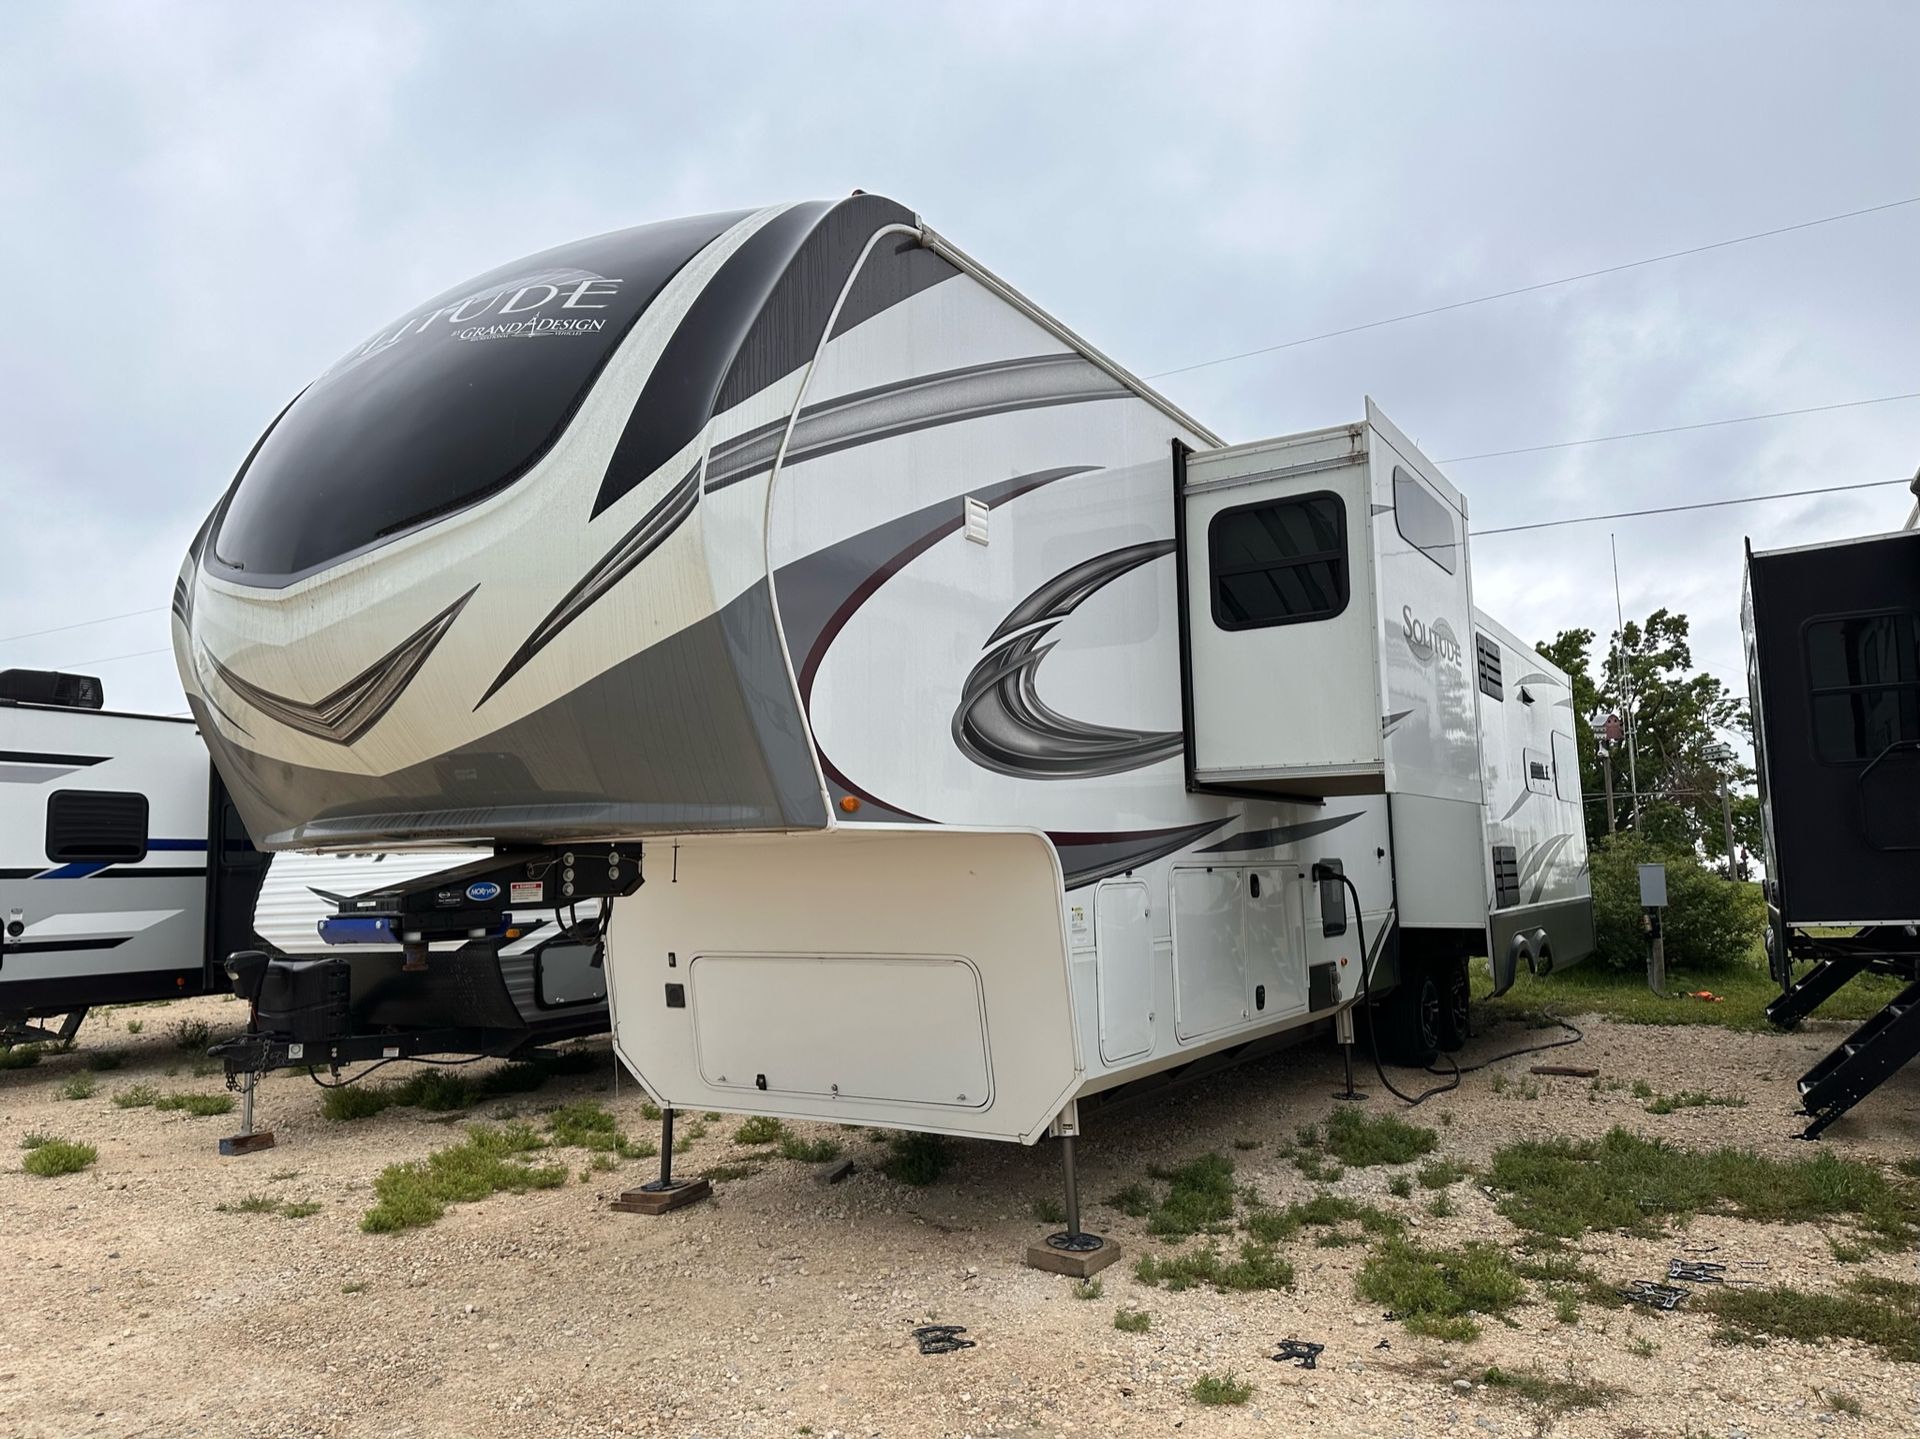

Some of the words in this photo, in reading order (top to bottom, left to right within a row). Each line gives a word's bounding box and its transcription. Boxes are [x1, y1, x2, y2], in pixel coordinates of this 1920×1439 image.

[343, 278, 624, 361] LITUDE
[460, 322, 522, 339] GRAND
[536, 318, 607, 331] DESIGN
